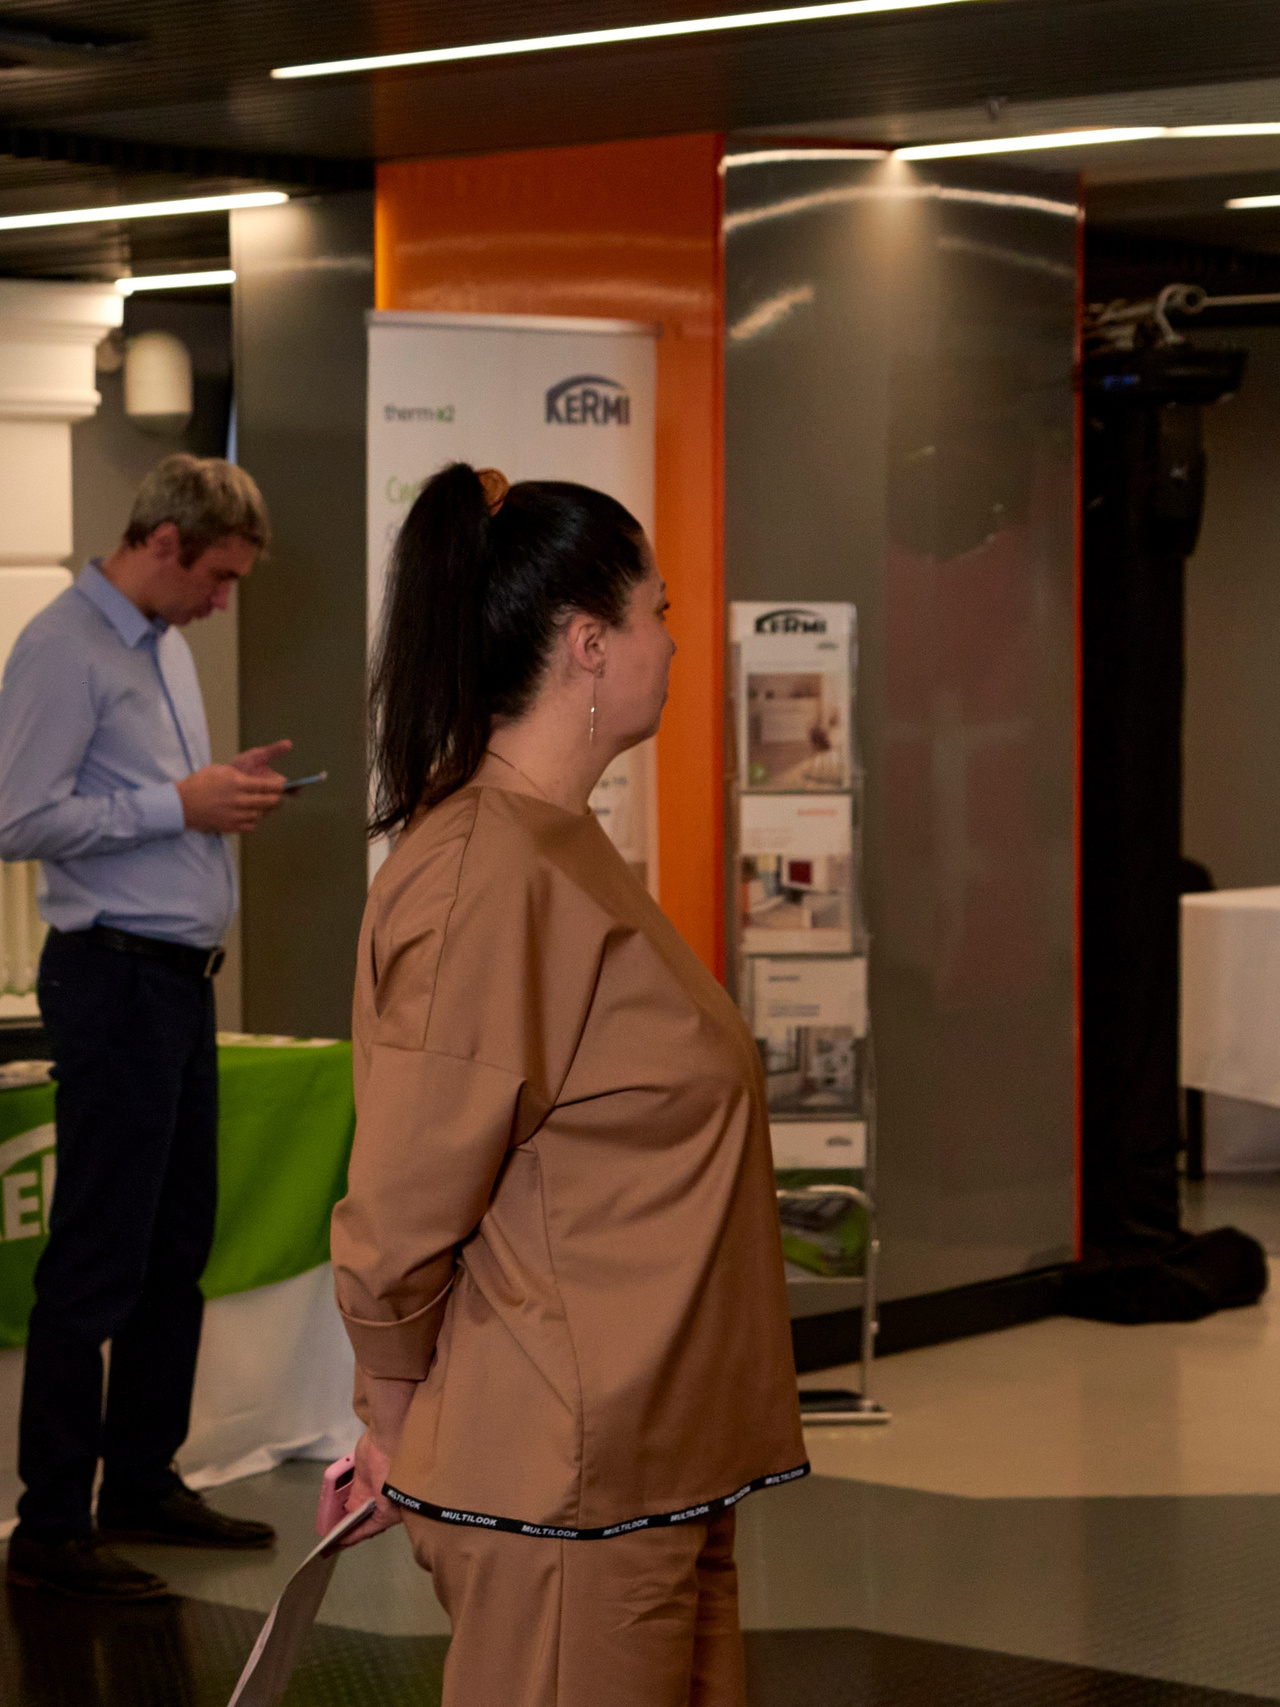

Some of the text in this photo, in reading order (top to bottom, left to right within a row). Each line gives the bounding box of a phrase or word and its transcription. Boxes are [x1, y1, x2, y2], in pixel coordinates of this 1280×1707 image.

[544, 388, 631, 425] KERMI
[440, 1510, 498, 1527] MULTILOOK
[521, 1524, 579, 1539] MULTILOOK
[602, 1518, 650, 1537] MULTILOOK
